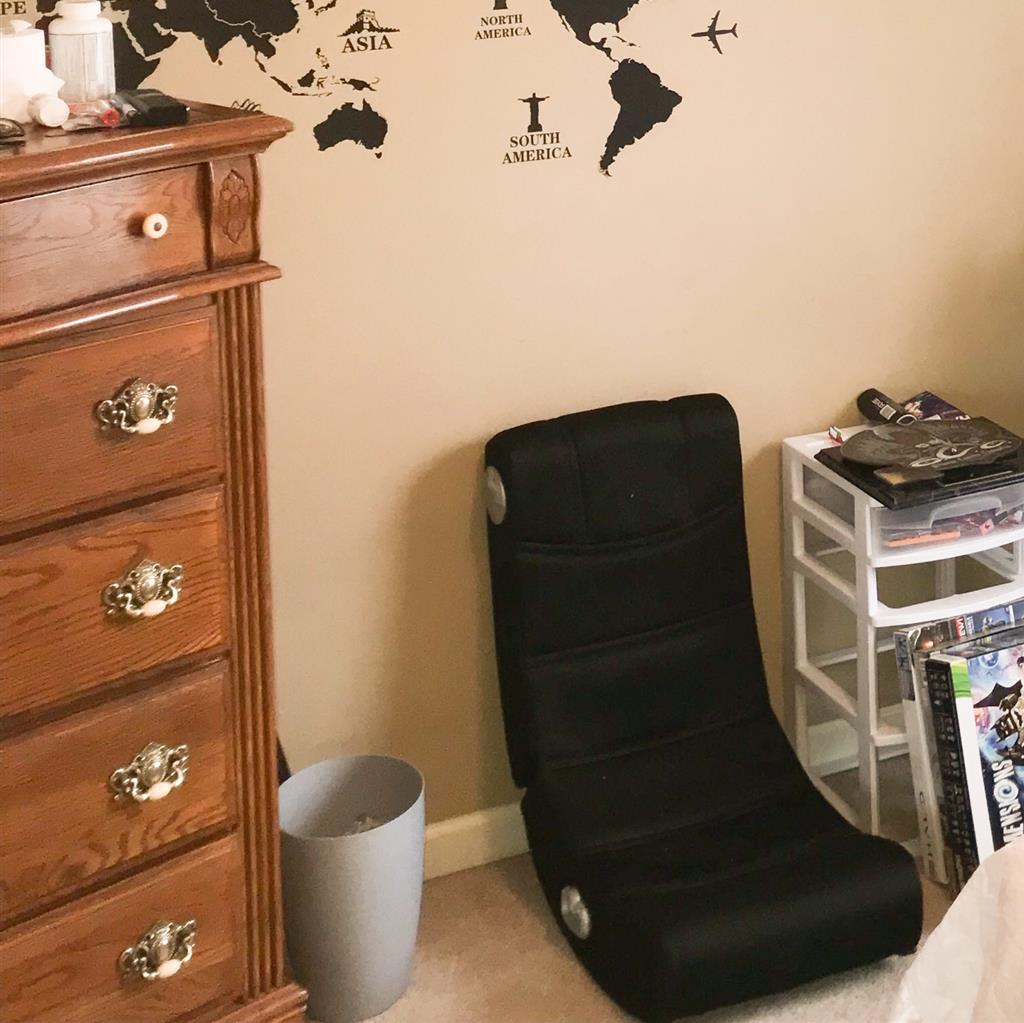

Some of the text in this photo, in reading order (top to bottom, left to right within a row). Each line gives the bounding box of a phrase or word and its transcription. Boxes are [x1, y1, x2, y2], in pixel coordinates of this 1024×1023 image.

[480, 13, 523, 27] NORTH
[474, 26, 532, 41] AMERICA
[341, 34, 393, 54] ASIA
[509, 131, 561, 148] SOUTH
[502, 146, 572, 165] AMERICA
